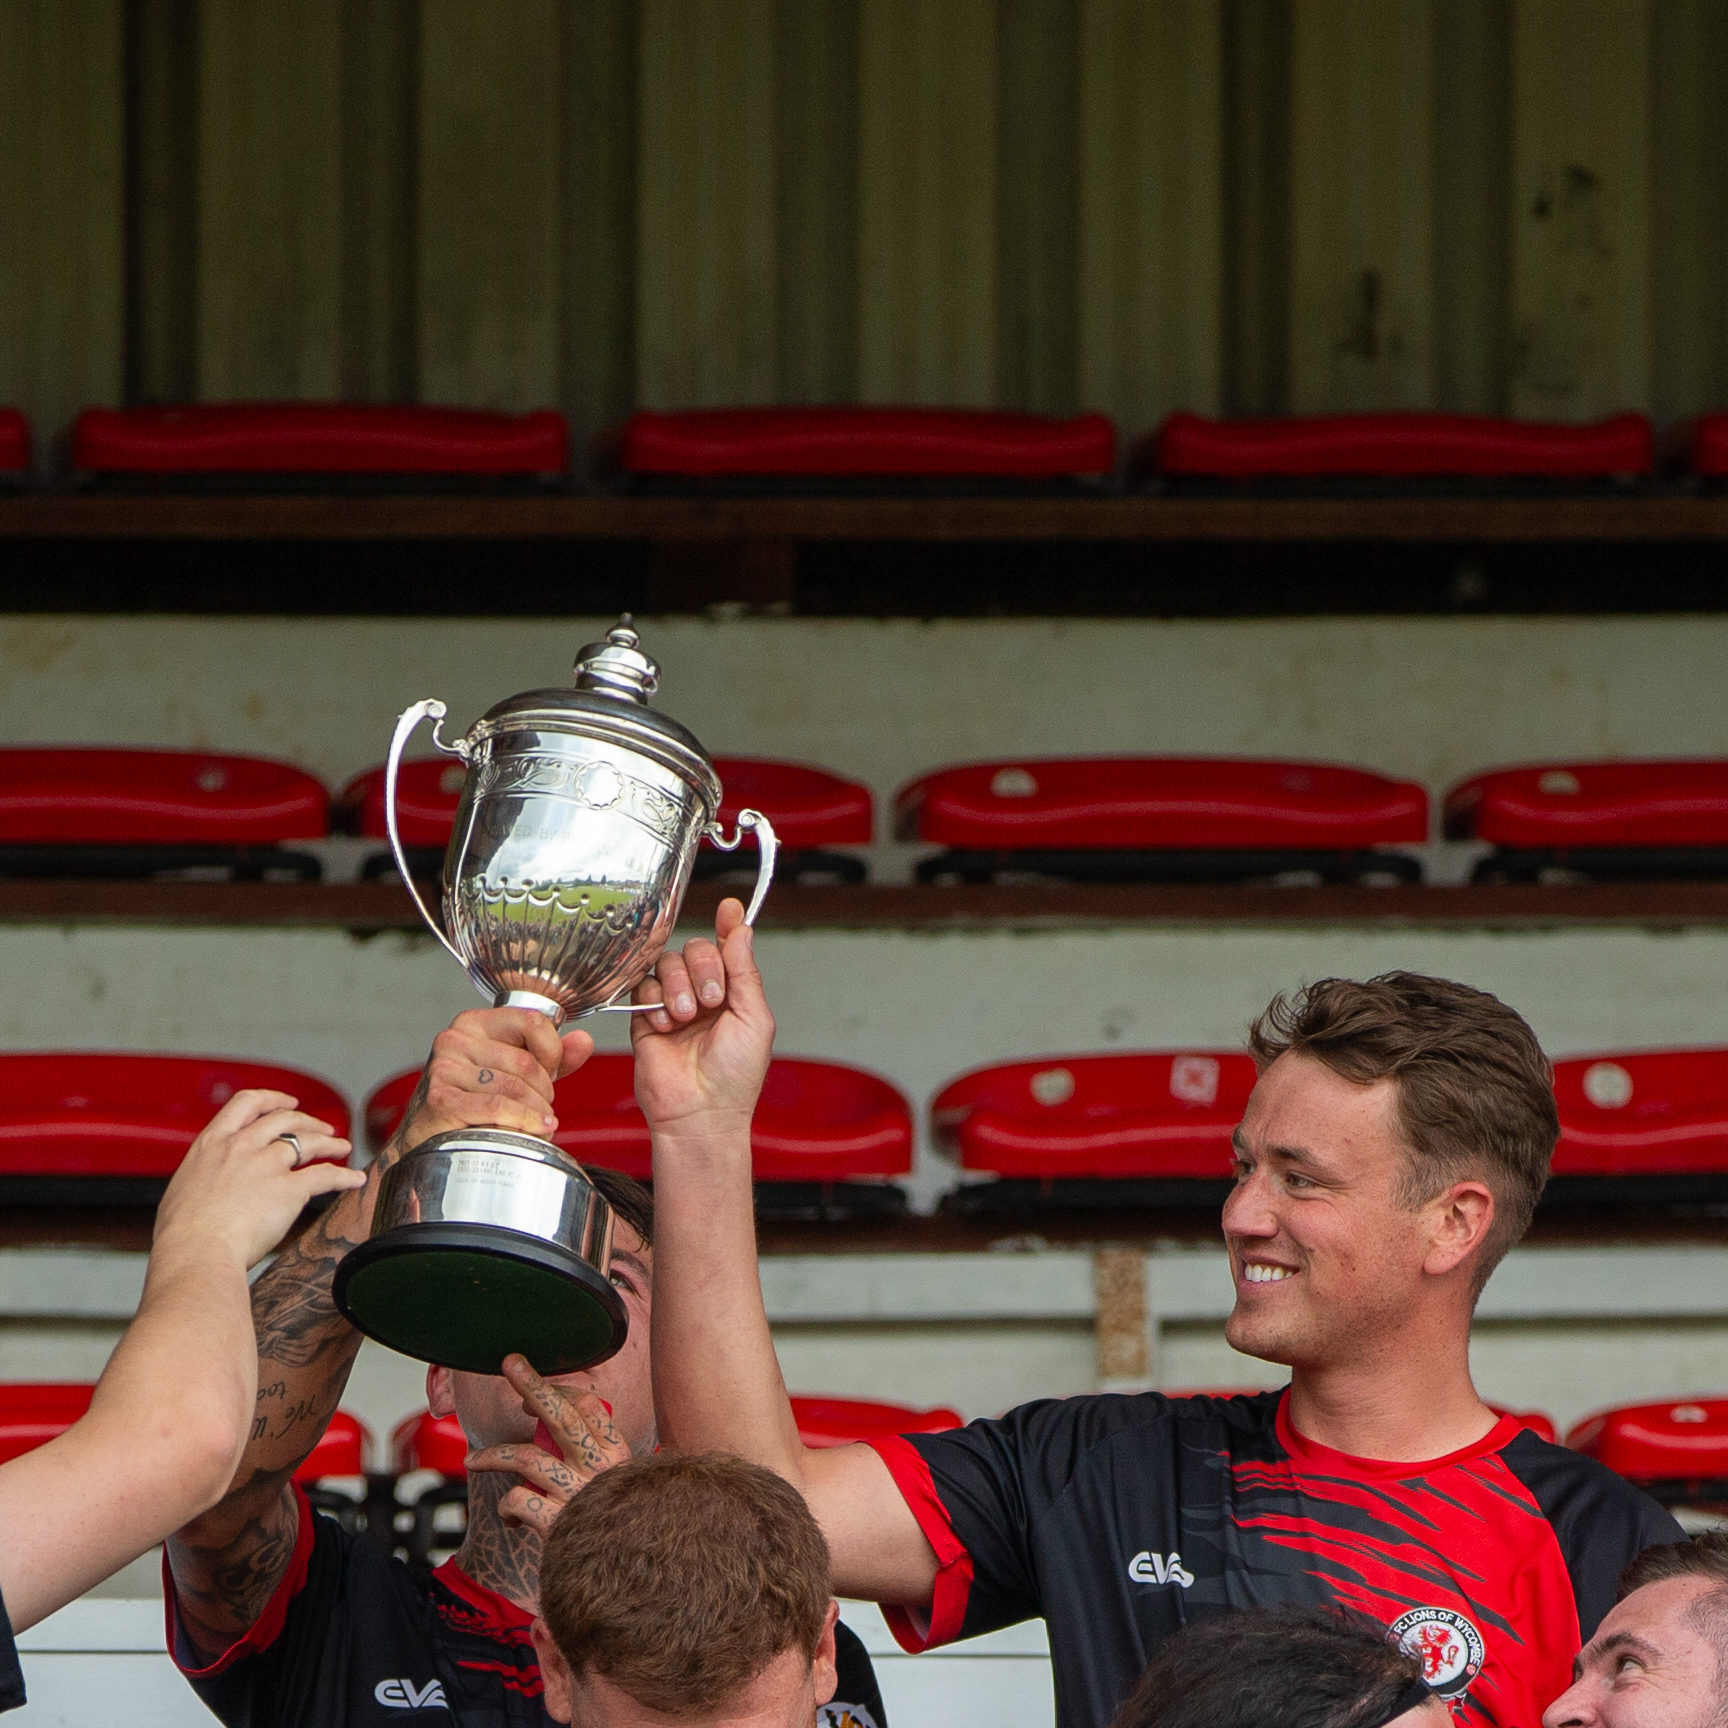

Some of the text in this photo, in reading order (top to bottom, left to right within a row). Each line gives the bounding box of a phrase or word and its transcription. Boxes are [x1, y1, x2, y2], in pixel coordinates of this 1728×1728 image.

[1393, 1610, 1482, 1666] FC LIONS OF WYCOMBE
